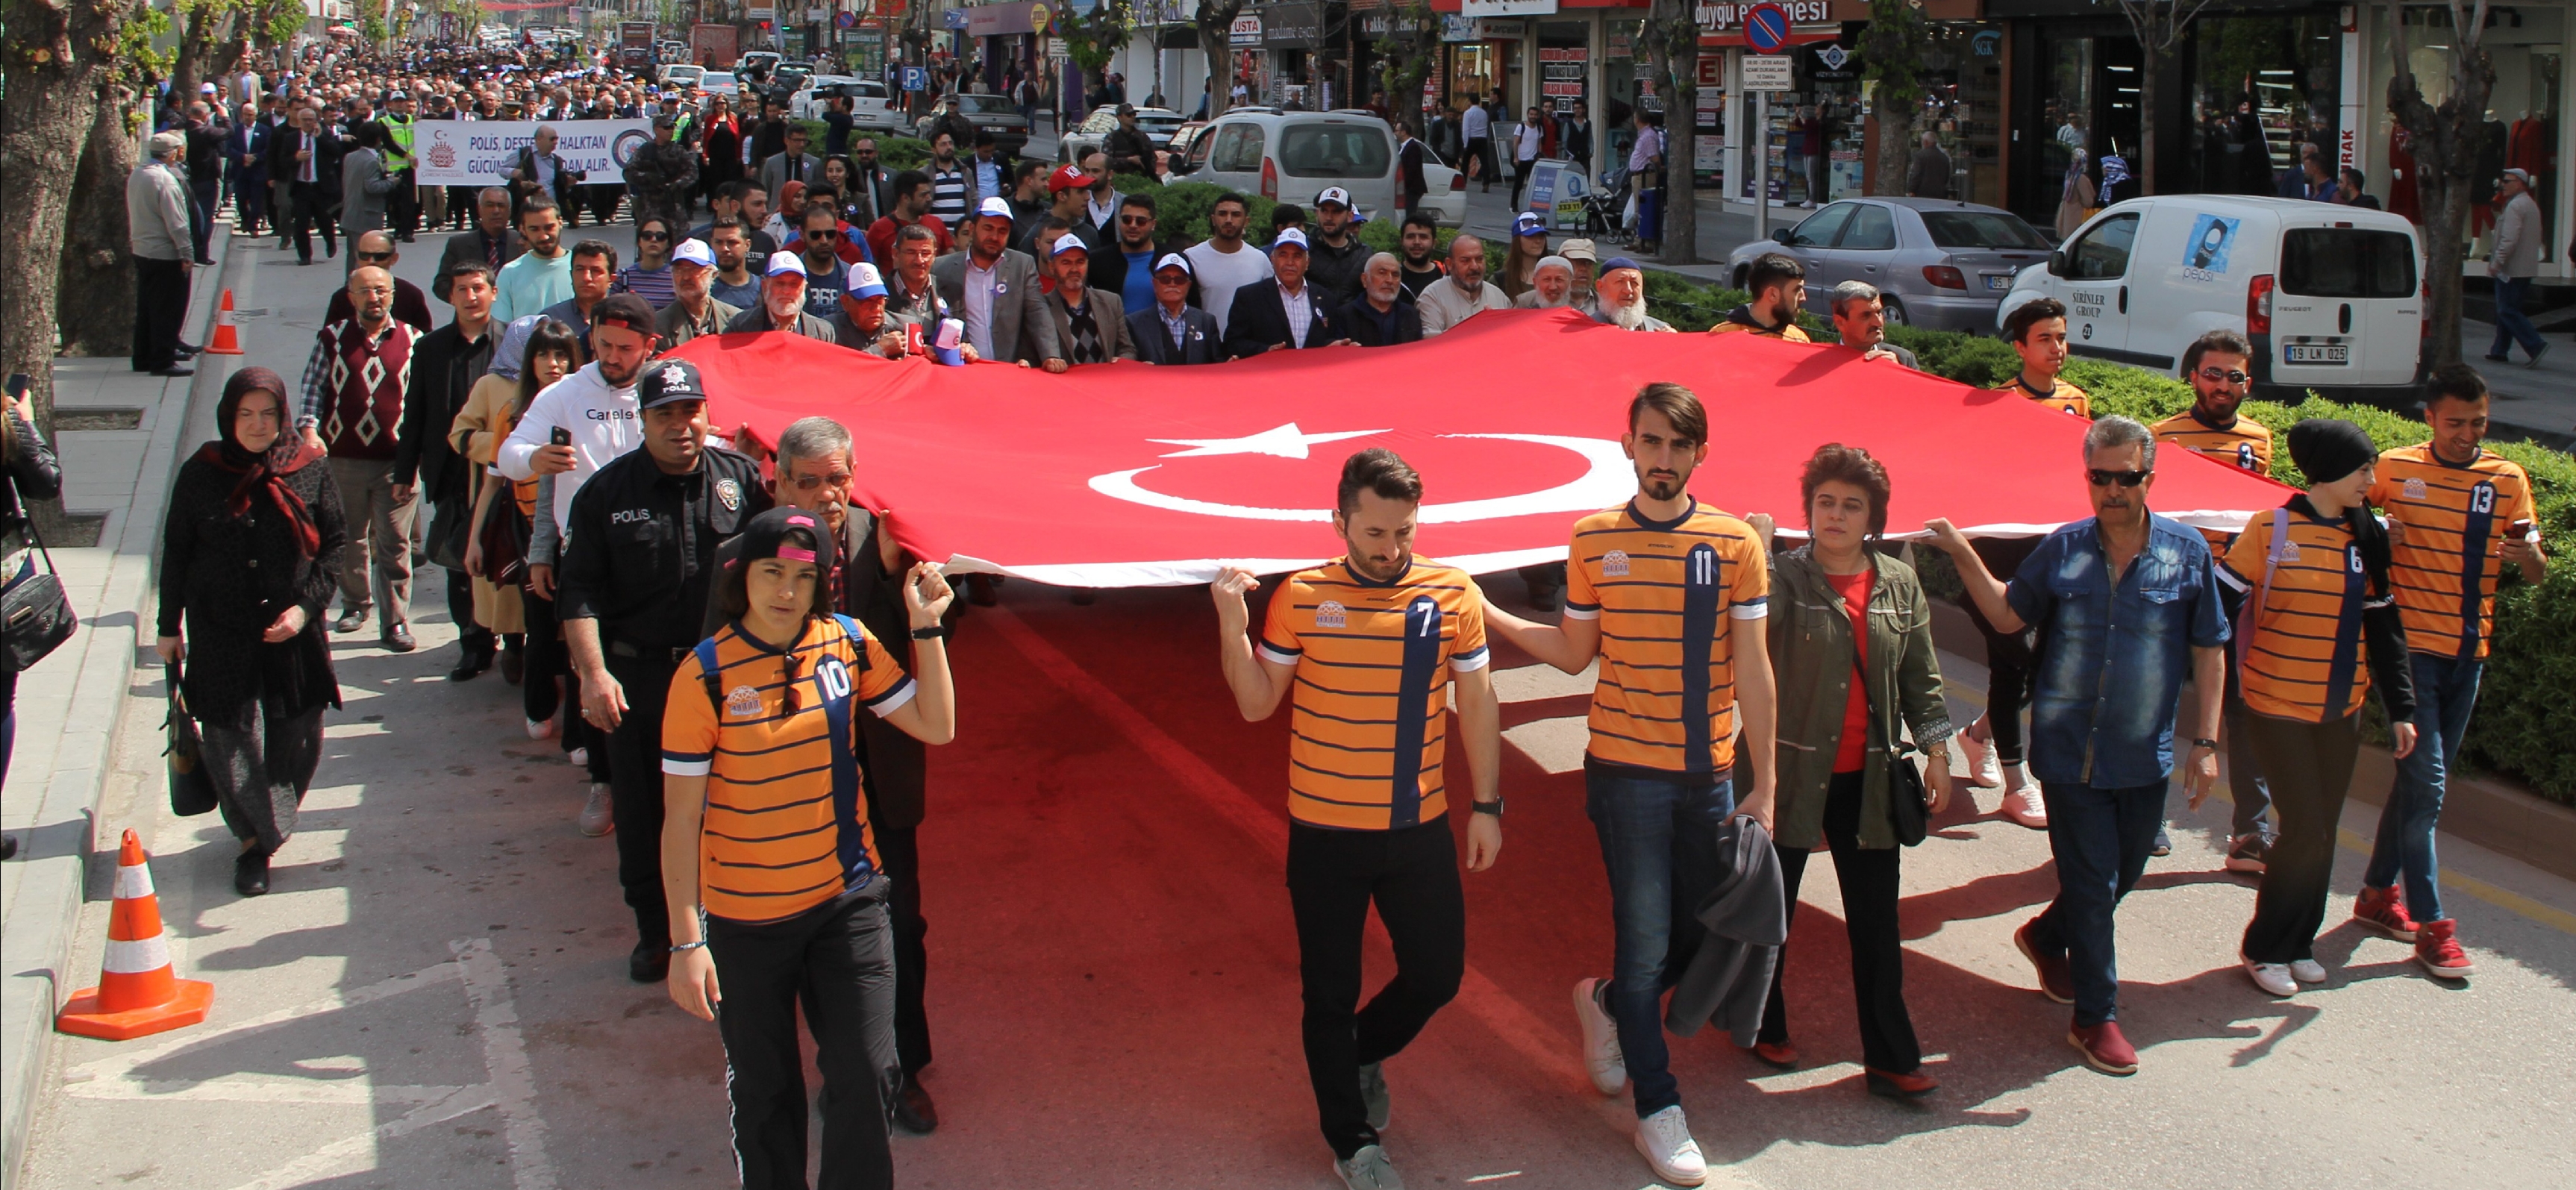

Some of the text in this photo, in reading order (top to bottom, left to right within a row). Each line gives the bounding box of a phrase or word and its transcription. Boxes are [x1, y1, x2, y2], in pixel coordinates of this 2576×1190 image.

[1234, 20, 1258, 32] USTA
[1975, 40, 1993, 56] SGK
[470, 133, 606, 152] POLİS, DESTE HALKTAN
[468, 156, 504, 173] GÜCÜN
[586, 157, 610, 172] ALIR.
[1992, 277, 2002, 287] 05
[2182, 268, 2213, 283] pepsi
[2072, 289, 2105, 305] ŞİRİNLER
[2076, 306, 2101, 318] GROUP
[2083, 327, 2091, 336] 21
[2292, 348, 2345, 360] 19 LN 025
[663, 383, 692, 393] POLİS
[586, 409, 634, 421] Carele
[2472, 485, 2494, 514] 13
[612, 509, 650, 524] POLİS
[2350, 545, 2363, 574] 6
[1695, 550, 1712, 585] 11
[1417, 601, 1434, 637] 7
[816, 660, 851, 701] 10
